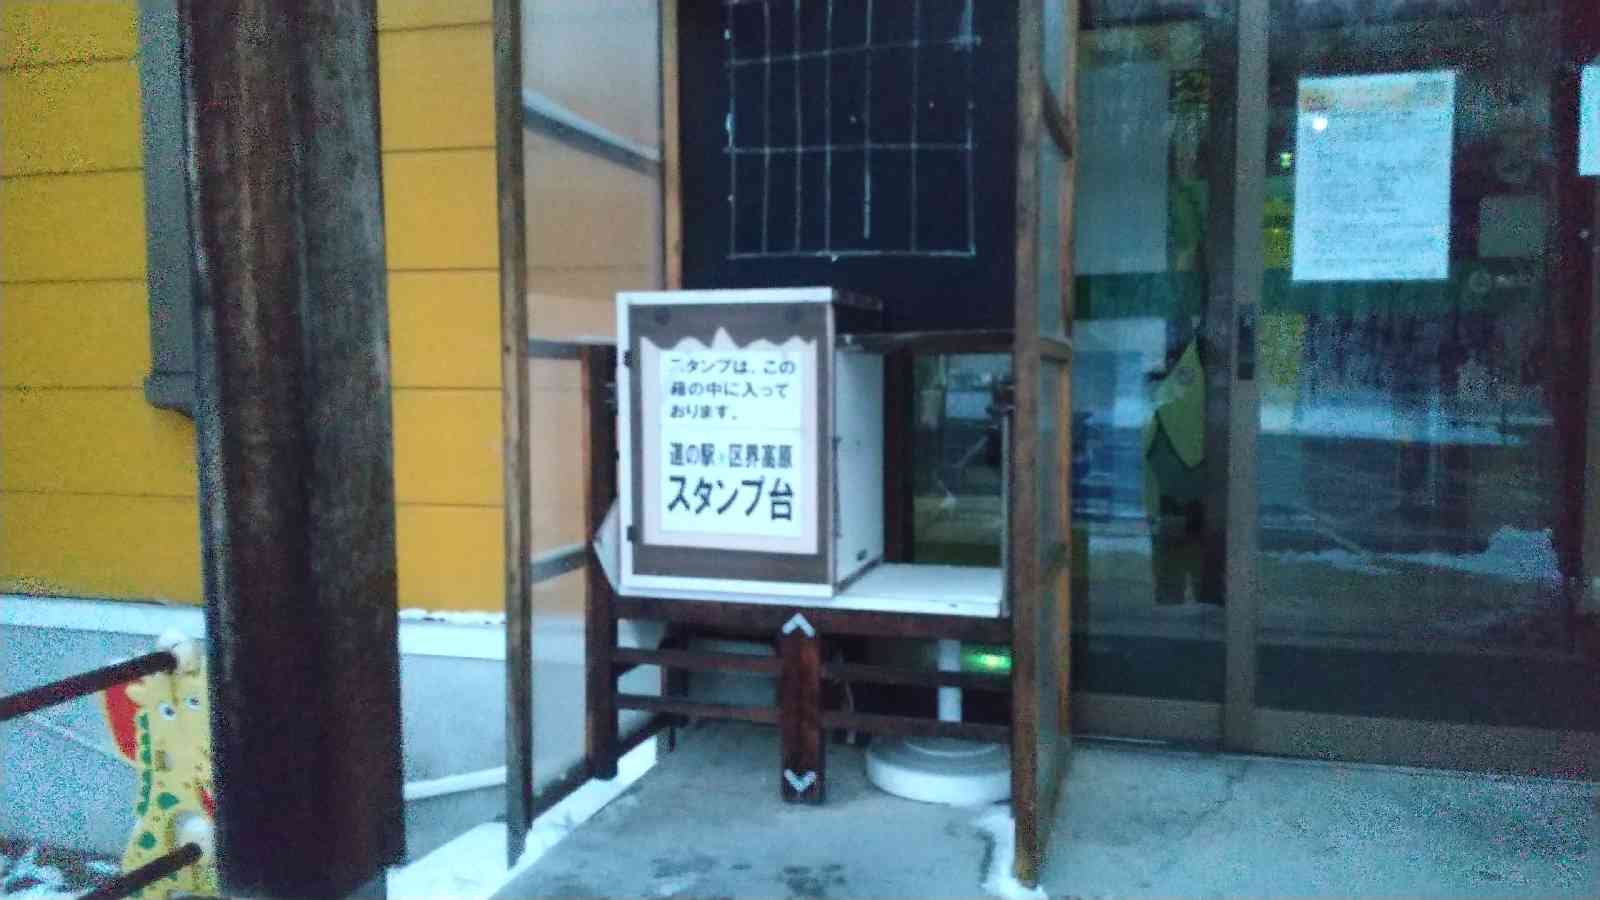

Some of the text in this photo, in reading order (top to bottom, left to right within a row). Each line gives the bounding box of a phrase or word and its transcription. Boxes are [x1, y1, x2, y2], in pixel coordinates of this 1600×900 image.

[667, 475, 793, 521] スタンプ台
